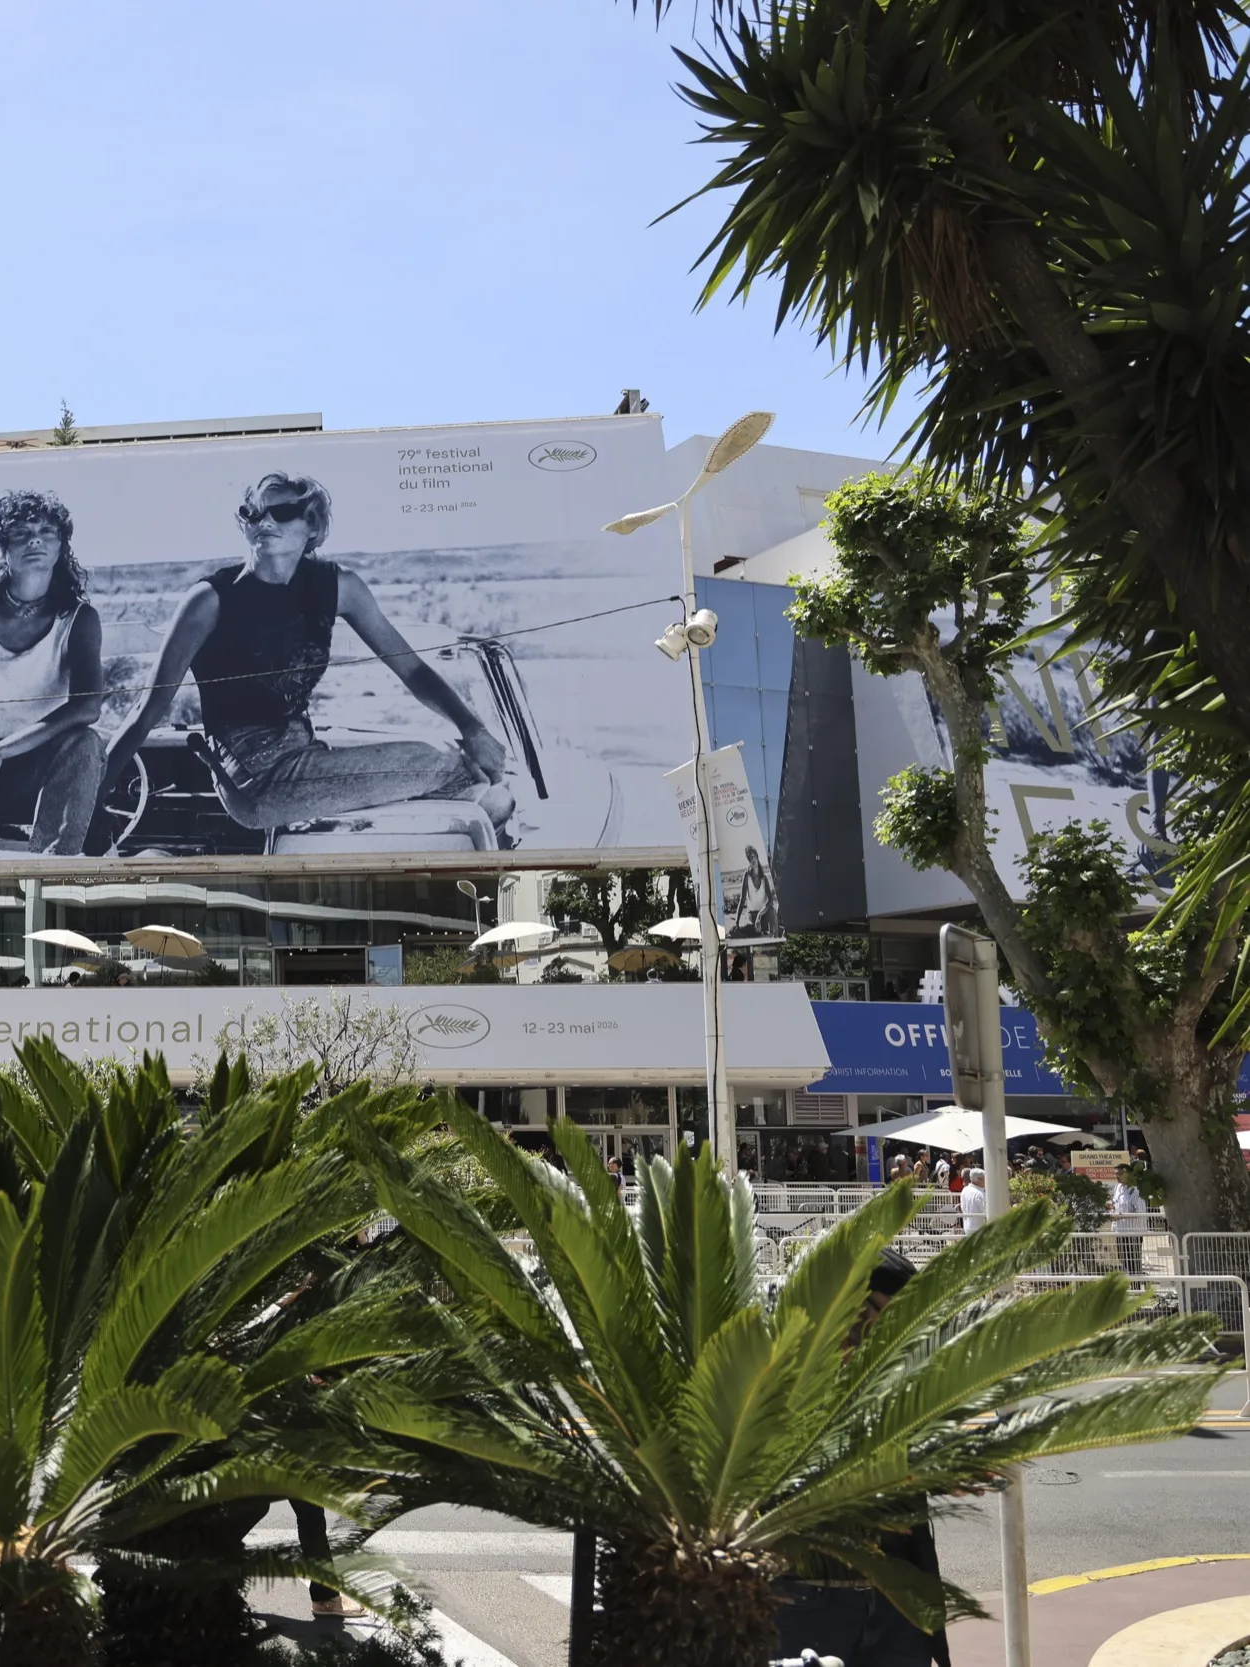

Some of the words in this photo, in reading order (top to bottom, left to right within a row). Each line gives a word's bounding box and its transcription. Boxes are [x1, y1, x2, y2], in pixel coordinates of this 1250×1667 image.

[426, 446, 481, 460] festival
[398, 461, 493, 475] international
[399, 479, 418, 490] du
[422, 478, 450, 488] film
[437, 503, 458, 512] mai
[570, 1022, 595, 1034] mai
[597, 1021, 618, 1029] 2026
[854, 1067, 909, 1076] INFORMATION
